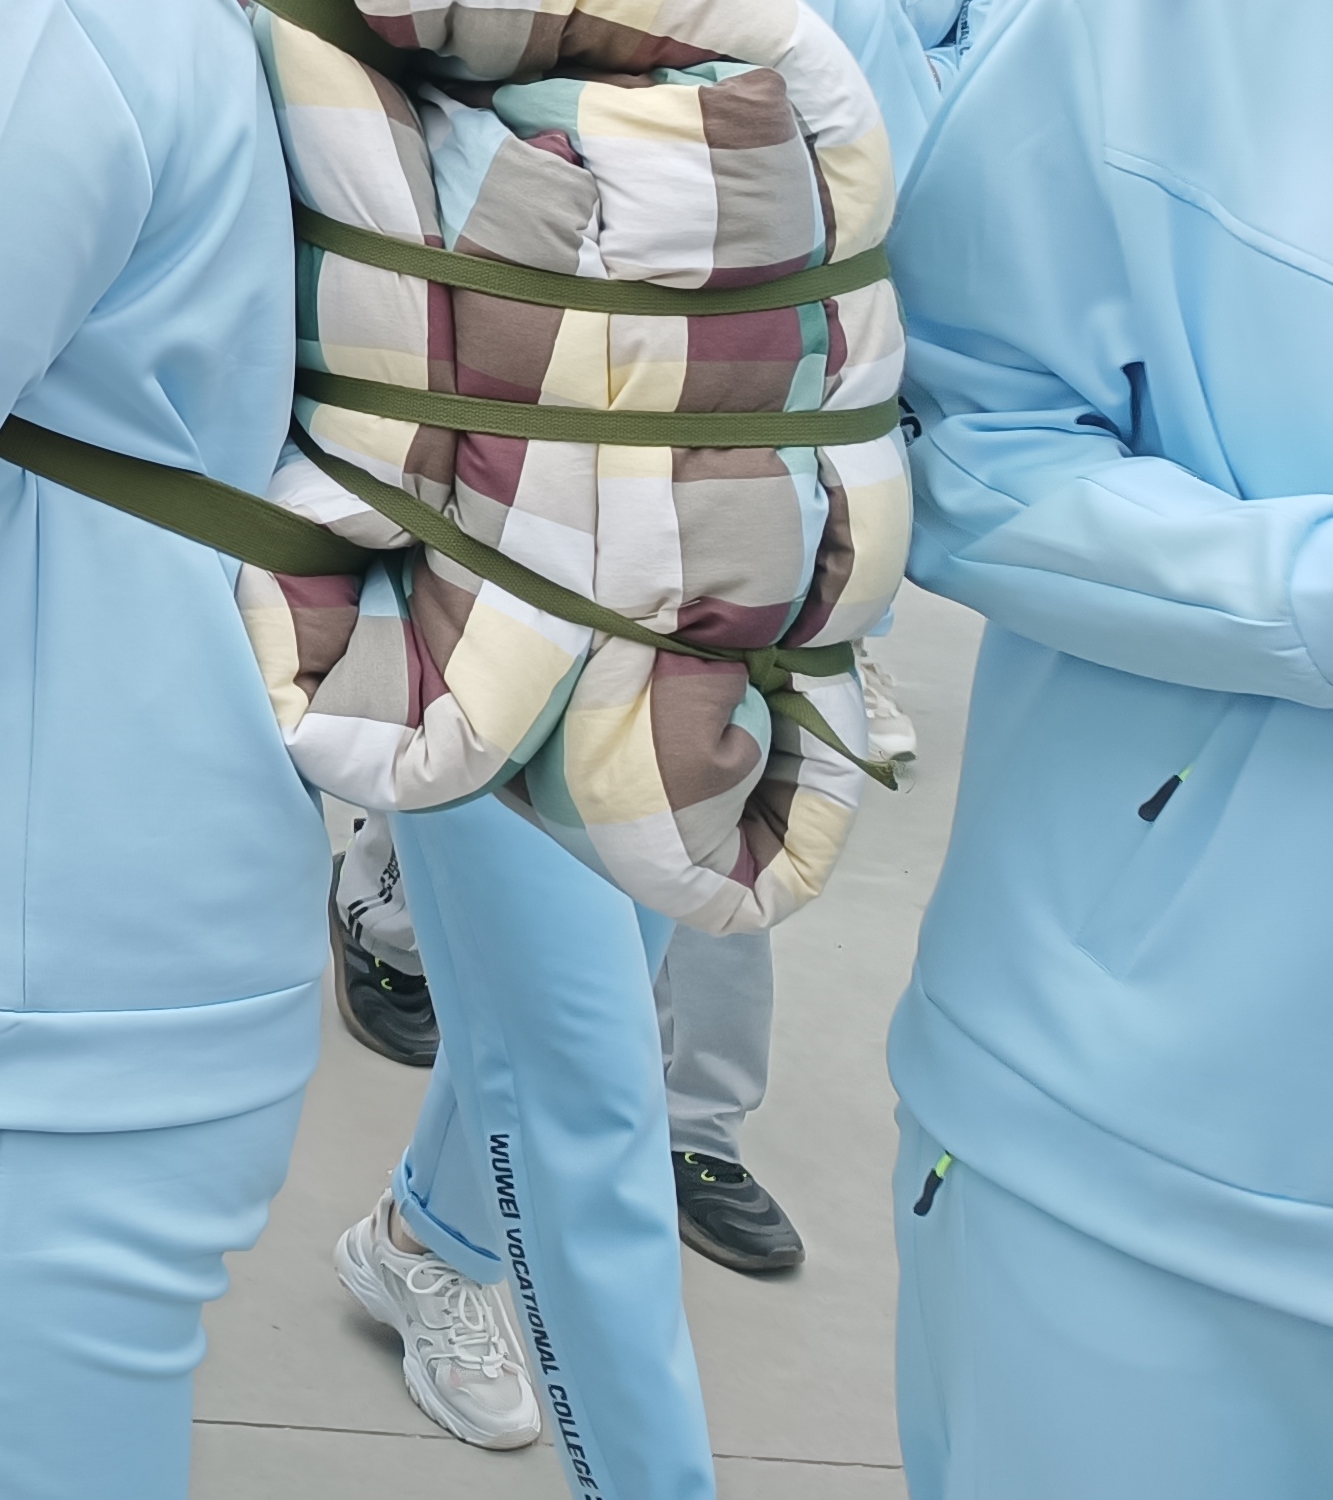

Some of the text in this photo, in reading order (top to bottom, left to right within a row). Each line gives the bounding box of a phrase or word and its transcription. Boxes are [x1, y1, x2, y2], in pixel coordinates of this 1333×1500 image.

[489, 1132, 599, 1491] WUWEI VOCATIONAL COLLEGE
